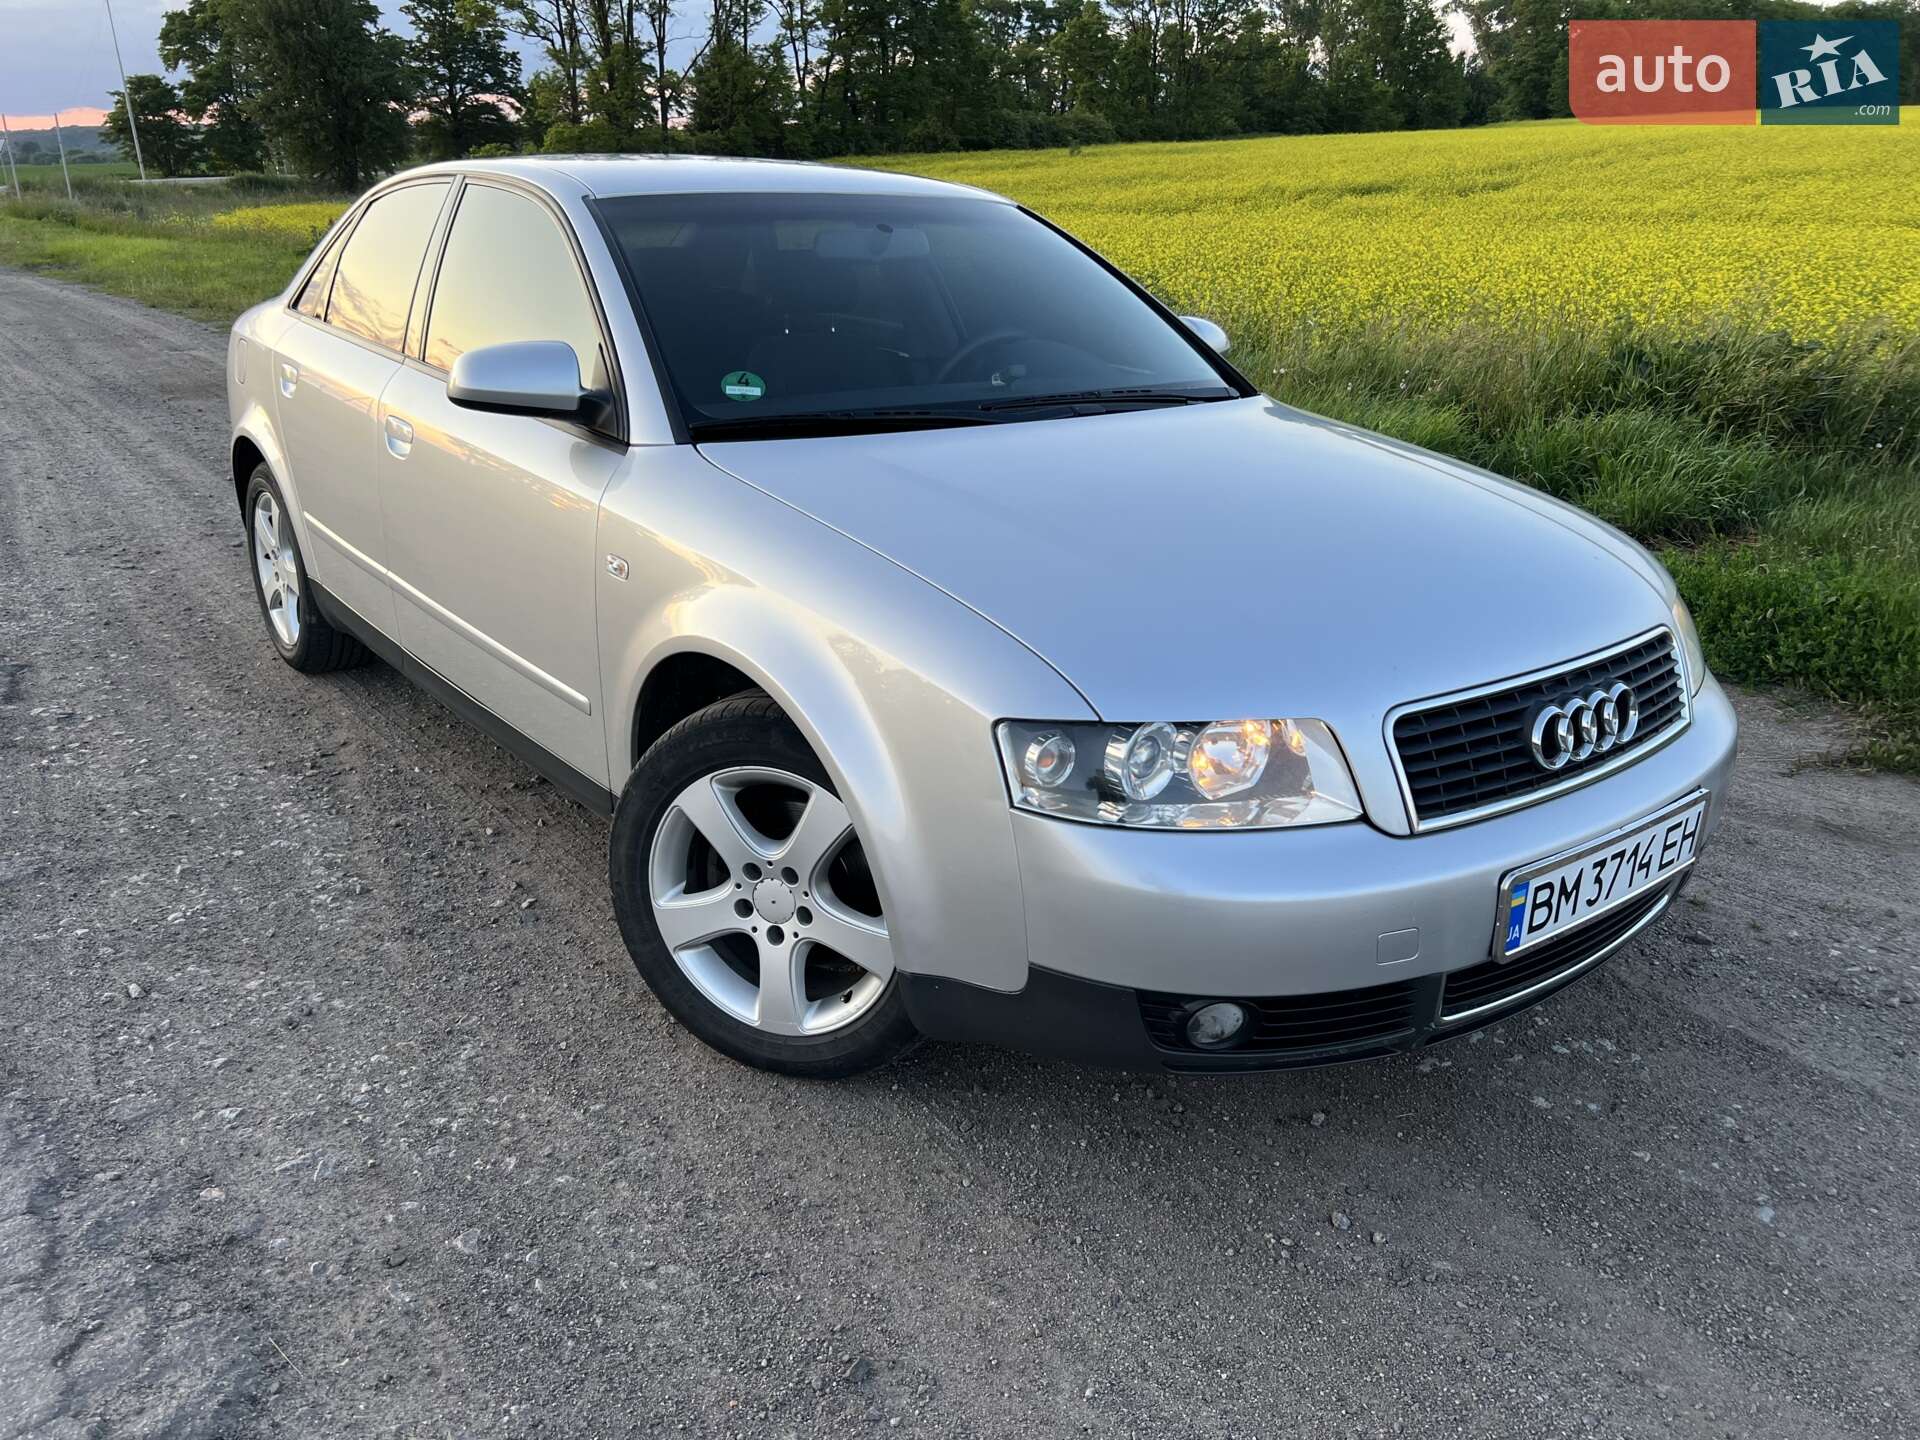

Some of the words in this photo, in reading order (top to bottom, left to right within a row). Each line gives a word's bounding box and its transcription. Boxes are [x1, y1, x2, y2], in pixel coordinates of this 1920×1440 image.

[737, 372, 750, 387] 4
[1527, 867, 1584, 935] BM
[1586, 834, 1657, 907] 3714
[1658, 810, 1702, 873] EH
